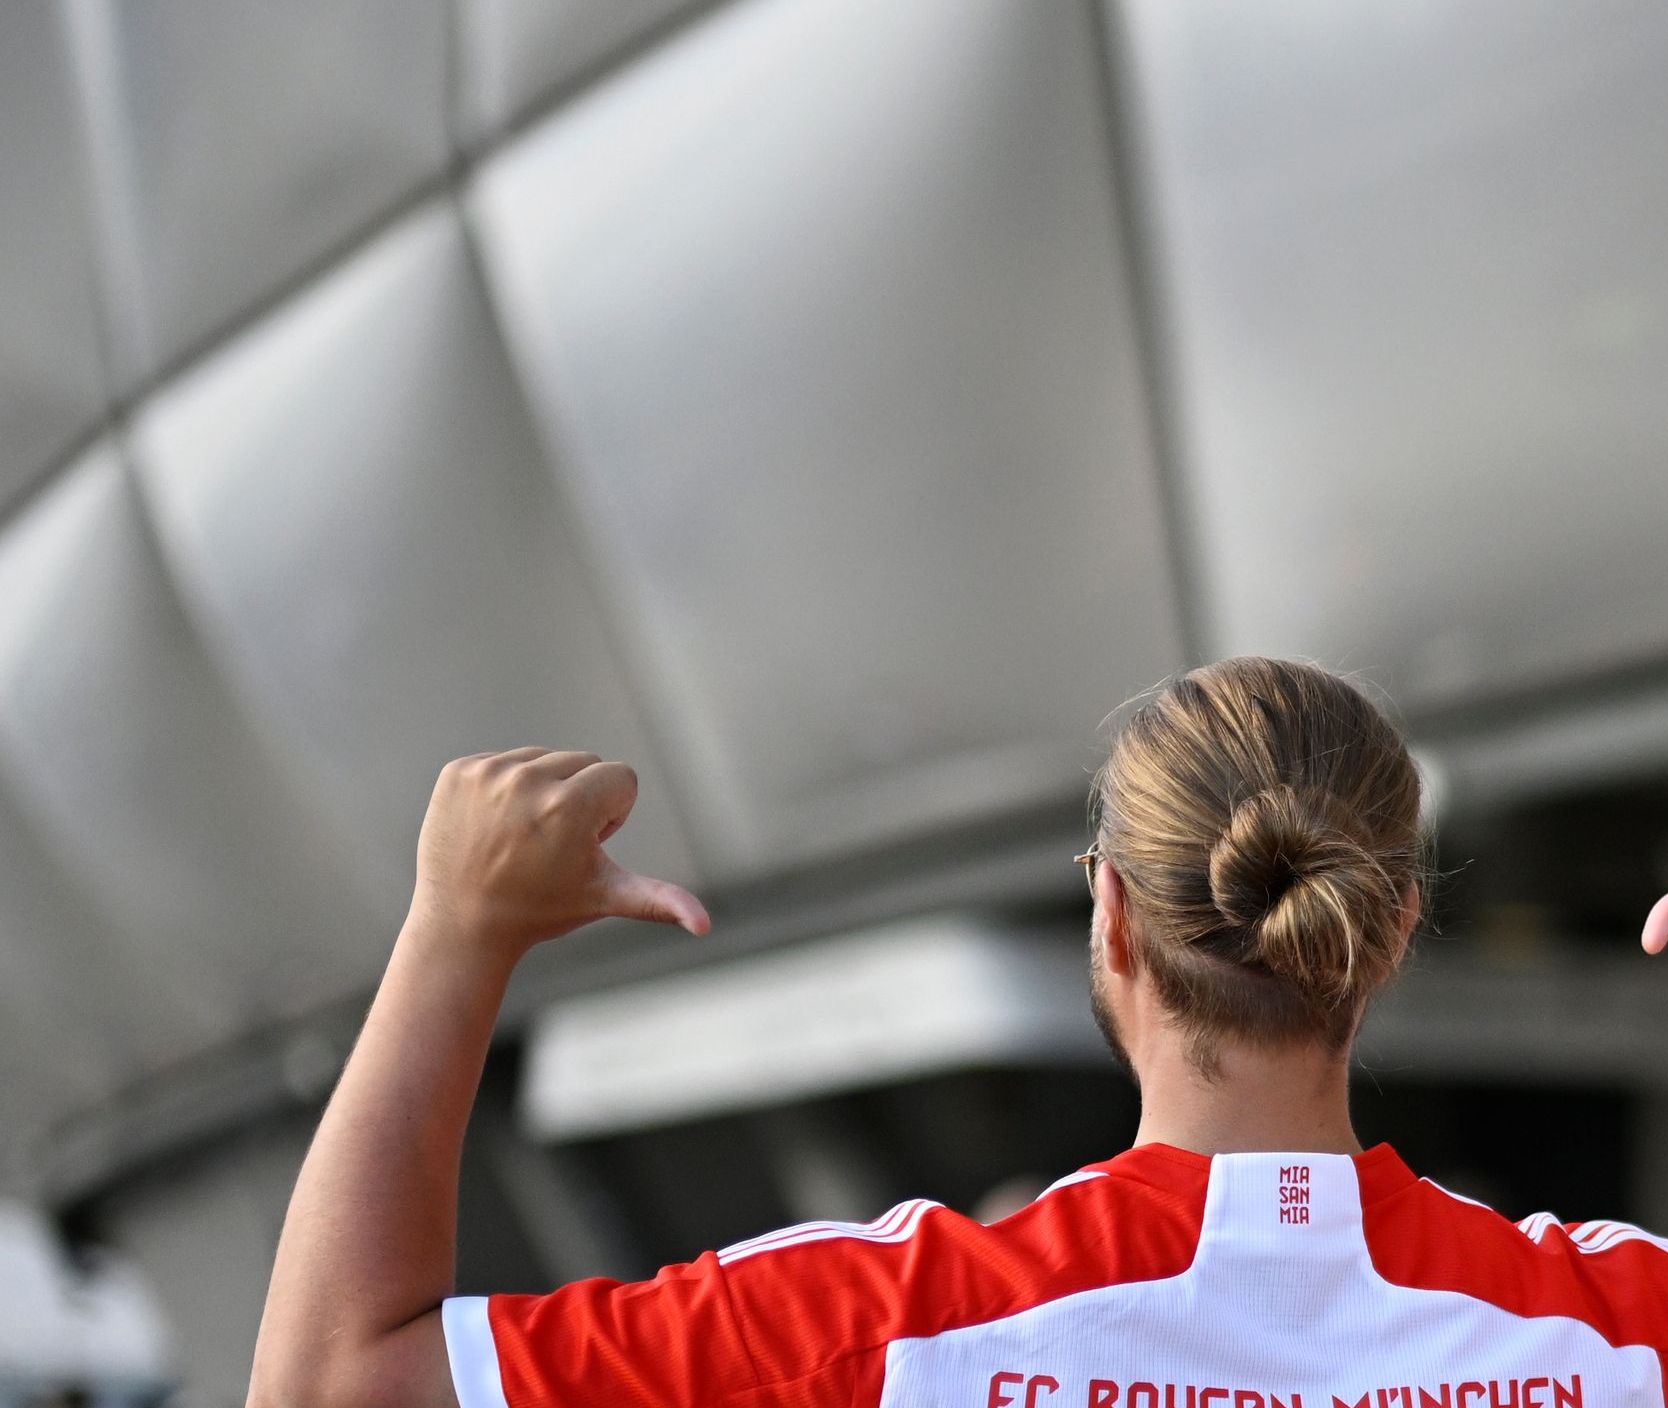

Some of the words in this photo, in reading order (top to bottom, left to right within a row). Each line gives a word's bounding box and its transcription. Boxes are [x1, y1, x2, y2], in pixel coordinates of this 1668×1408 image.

[1280, 1166, 1310, 1184] MIA
[1279, 1186, 1310, 1204] SAN
[1280, 1206, 1310, 1224] MIA
